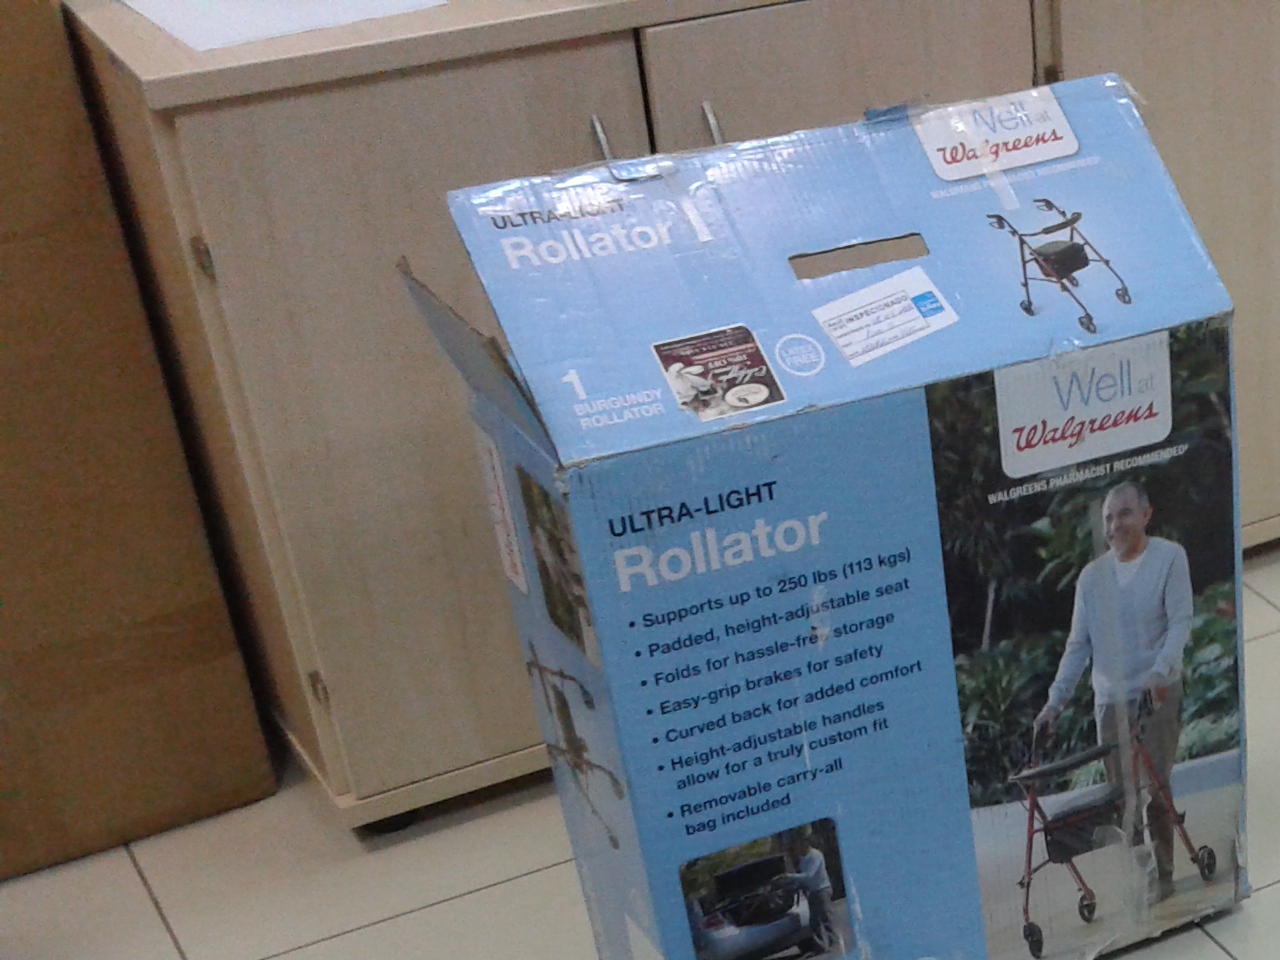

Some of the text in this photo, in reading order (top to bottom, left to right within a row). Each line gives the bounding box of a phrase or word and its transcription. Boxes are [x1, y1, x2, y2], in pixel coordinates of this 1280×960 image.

[501, 220, 674, 270] Rollator
[561, 369, 587, 400] 1
[573, 388, 662, 416] BURGUNDY
[1052, 359, 1154, 412] Well at
[580, 403, 665, 430] ROLLATOR
[1012, 401, 1159, 452] Walgreens
[608, 480, 777, 538] ULTRA-LIGHT
[987, 477, 1049, 505] WALGREENS
[1049, 463, 1111, 489] PHARMACIST
[613, 511, 829, 594] Rollator
[642, 547, 912, 628] Supports up to 250 lbs (113 kgs)
[648, 578, 910, 657] Padded, height-adjustable seat
[654, 612, 895, 686] Folds for hassle-fre storage
[659, 645, 884, 715] Easy-grip brakes for safety
[664, 660, 922, 743] Curved back for added comfort
[670, 700, 885, 771] Height-adjustable handles
[676, 717, 889, 791] allow for a truly custom fit
[680, 758, 843, 818] Removable carry-all
[685, 792, 791, 837] bag included
